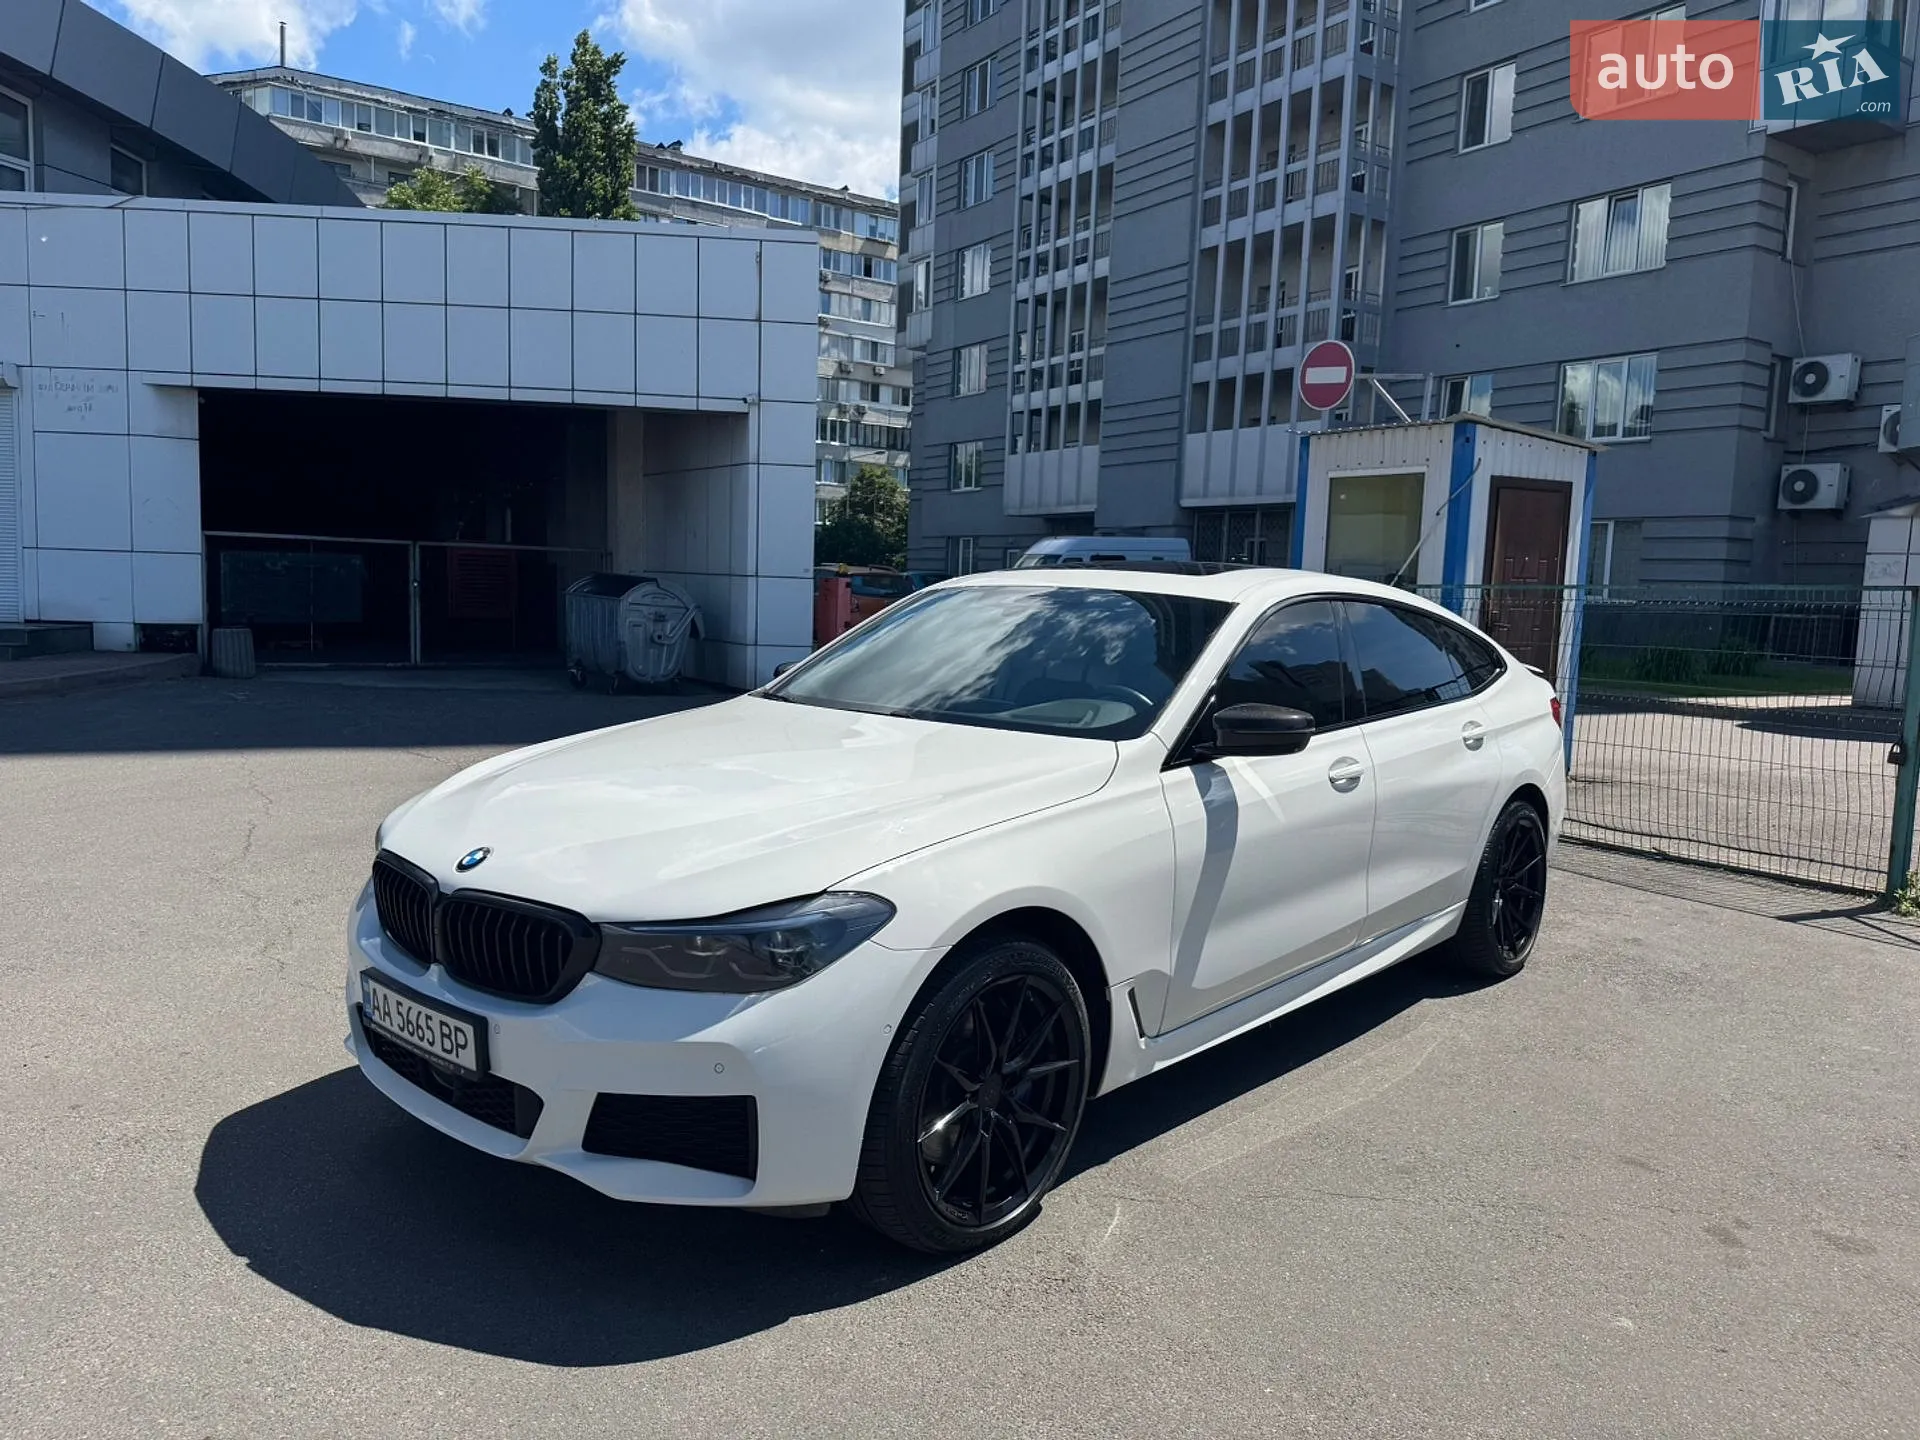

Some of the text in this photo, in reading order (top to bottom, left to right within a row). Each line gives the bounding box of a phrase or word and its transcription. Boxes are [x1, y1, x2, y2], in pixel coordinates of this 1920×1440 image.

[372, 988, 393, 1027] AA
[396, 1001, 435, 1047] 5665
[440, 1020, 468, 1058] BP
